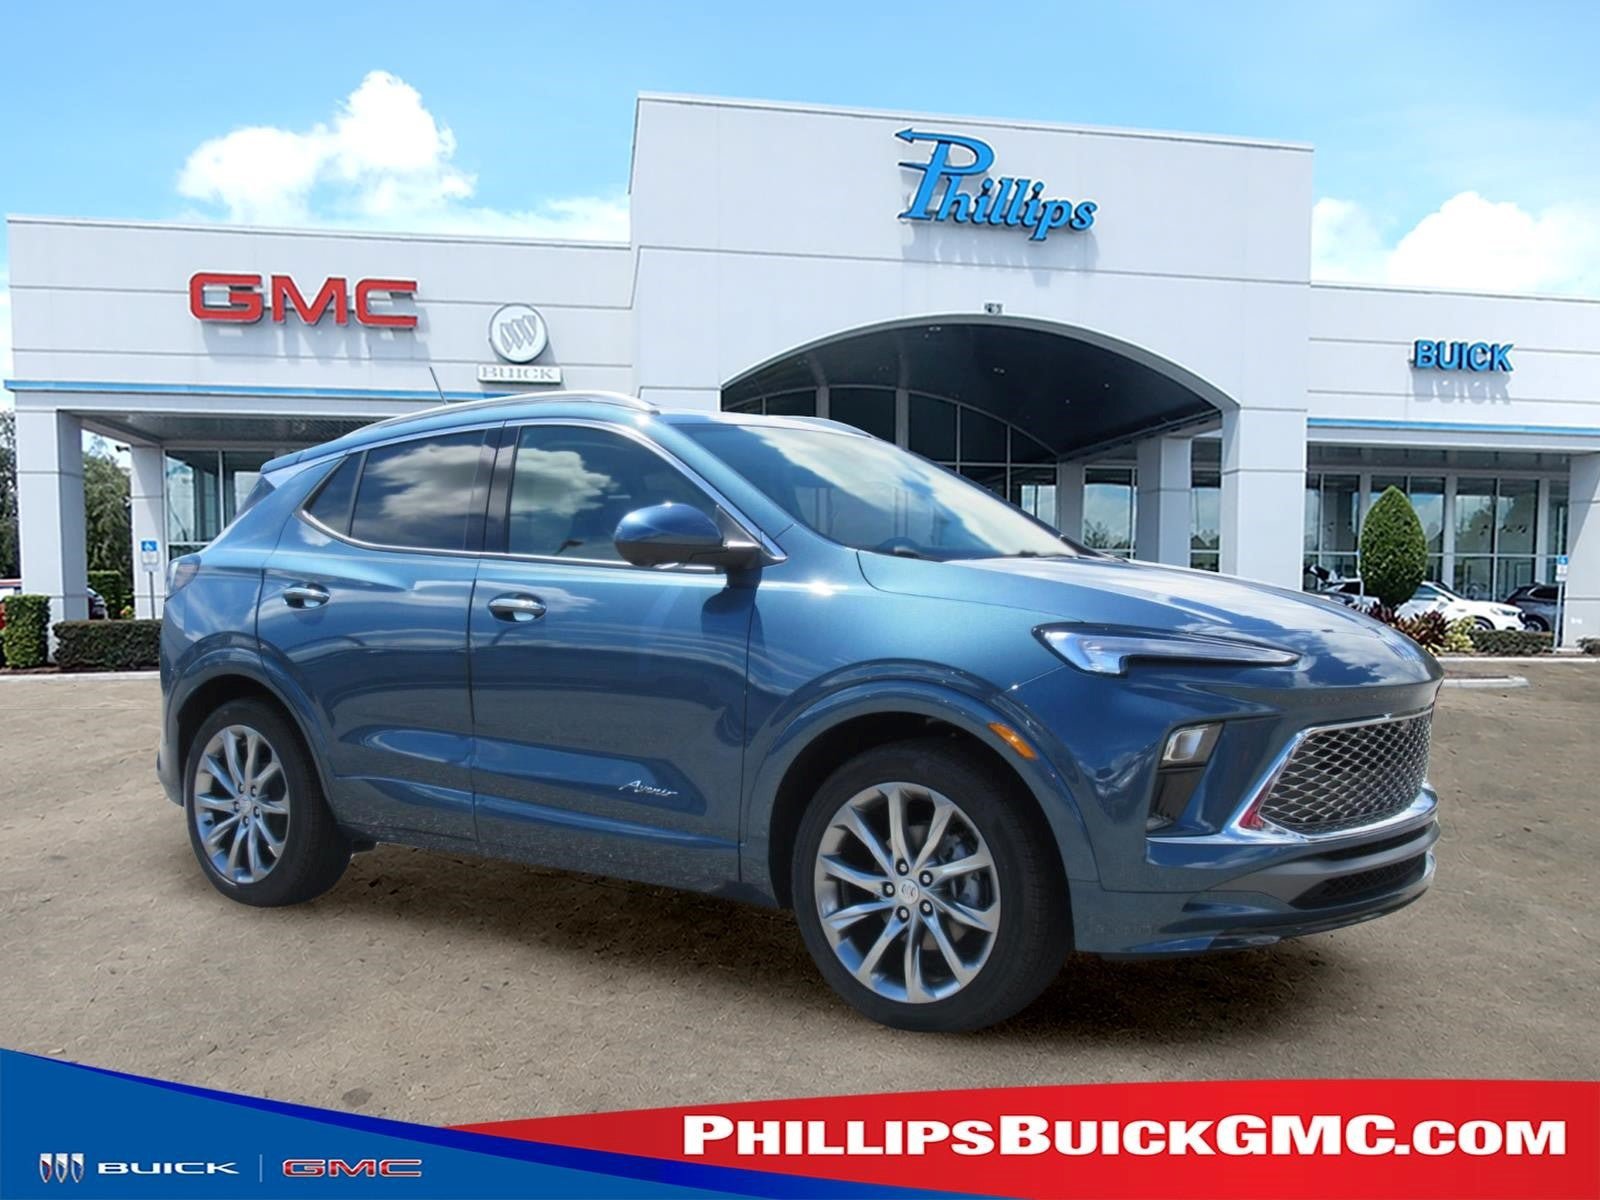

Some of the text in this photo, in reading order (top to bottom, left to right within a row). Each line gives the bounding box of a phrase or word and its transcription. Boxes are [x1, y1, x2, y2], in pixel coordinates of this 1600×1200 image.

[895, 128, 1098, 241] Phillips
[190, 271, 418, 329] GMC
[482, 367, 554, 380] BUICK
[1414, 339, 1514, 372] BUICK
